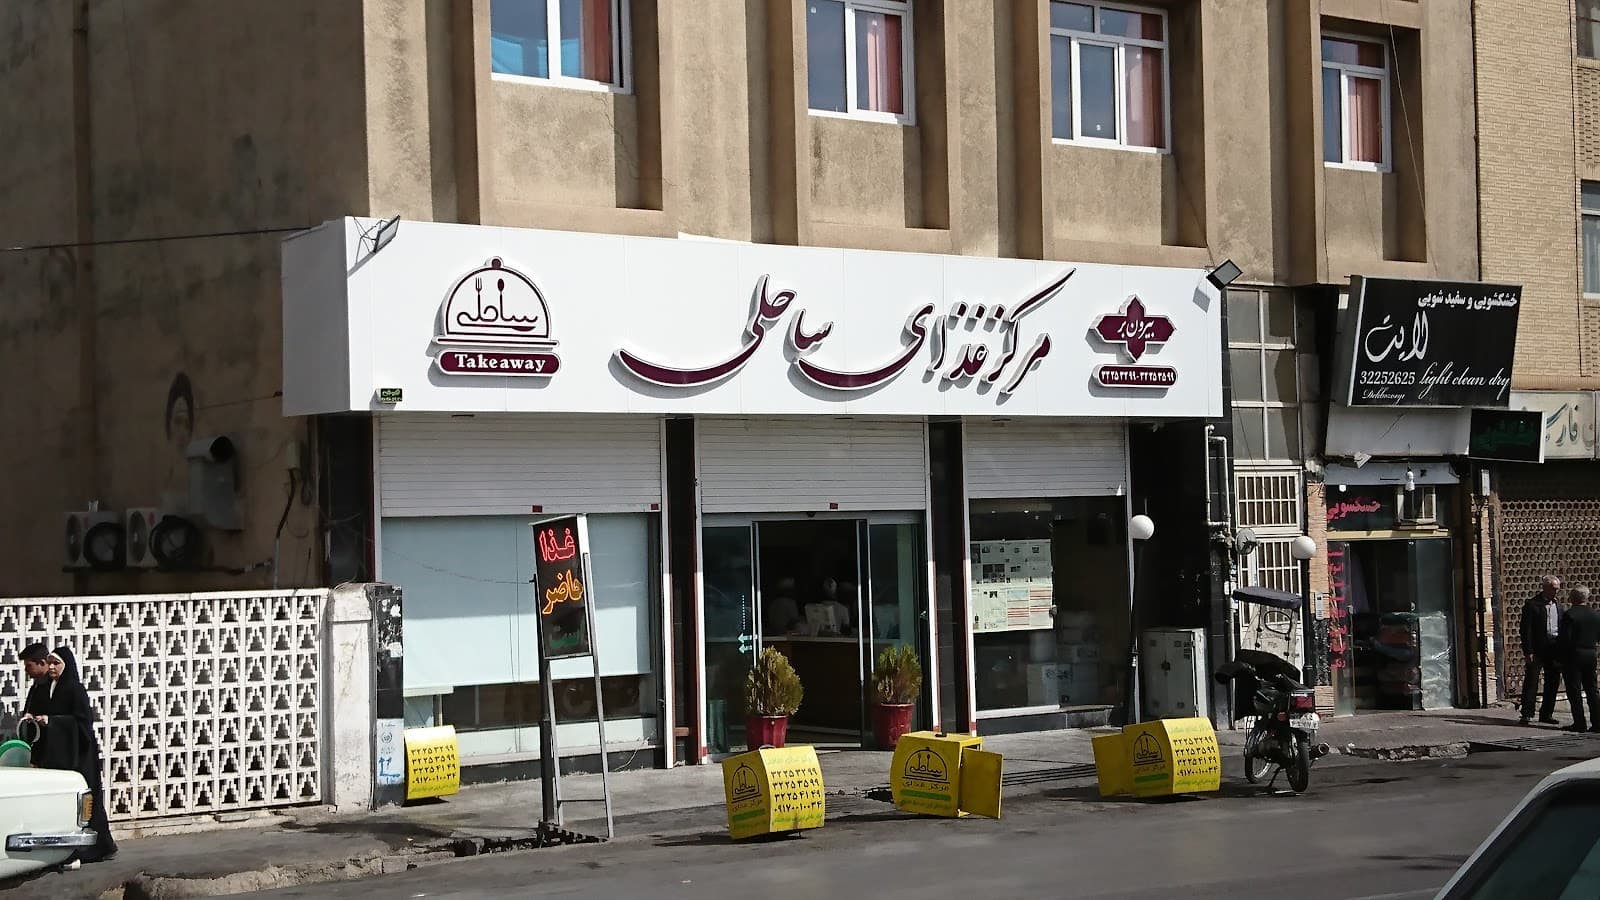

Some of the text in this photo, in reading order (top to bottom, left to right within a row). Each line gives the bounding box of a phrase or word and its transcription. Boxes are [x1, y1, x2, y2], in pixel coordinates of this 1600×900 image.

[1417, 289, 1518, 310] خشکشویی و سفید شویی
[618, 274, 834, 388] ساحلی
[988, 268, 1076, 393] مرکز
[1364, 310, 1429, 363] لایت
[454, 353, 546, 373] Takeaway
[1359, 370, 1416, 385] 32252625
[1451, 366, 1487, 386] clean
[1488, 367, 1511, 400] dry
[539, 527, 576, 562] غذا
[541, 569, 584, 615] حاضر
